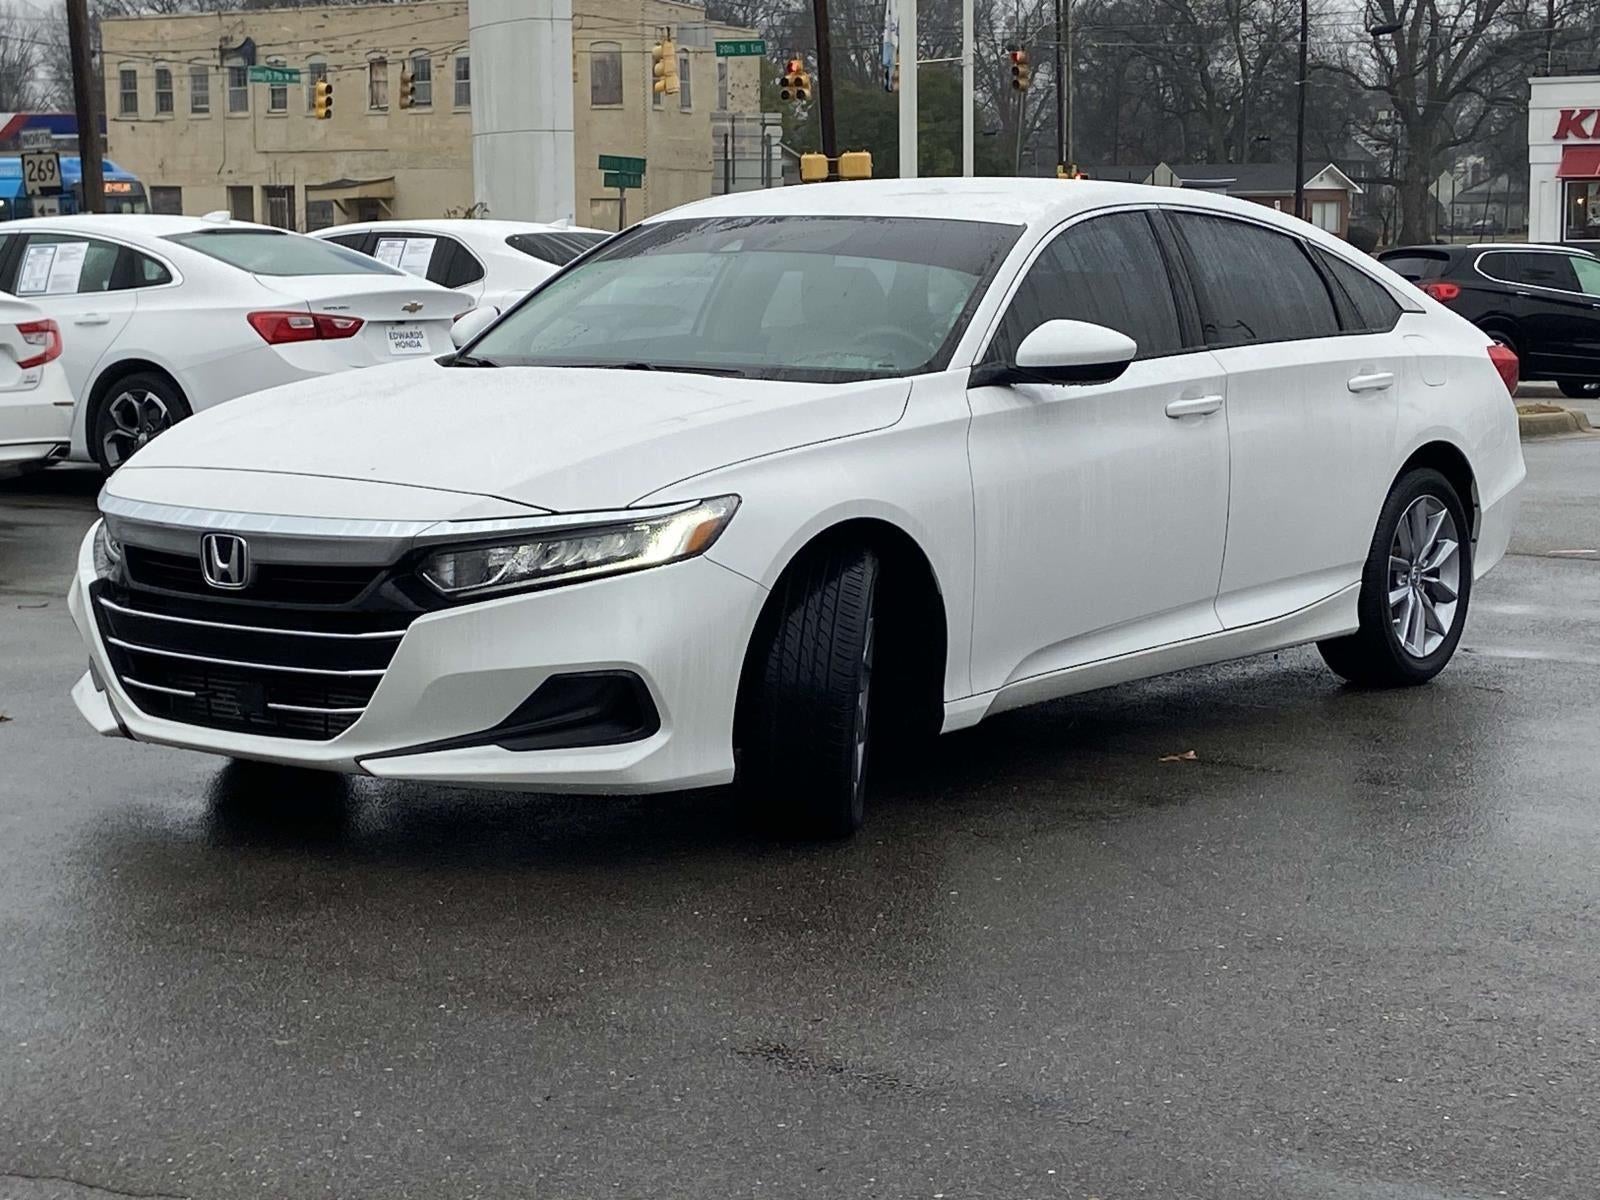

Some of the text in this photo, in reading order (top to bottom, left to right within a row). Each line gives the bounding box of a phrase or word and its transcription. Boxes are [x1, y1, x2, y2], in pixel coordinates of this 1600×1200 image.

[1552, 109, 1600, 140] K
[26, 159, 56, 182] 269
[388, 331, 424, 341] EDWARDS
[394, 340, 422, 349] HONDA
